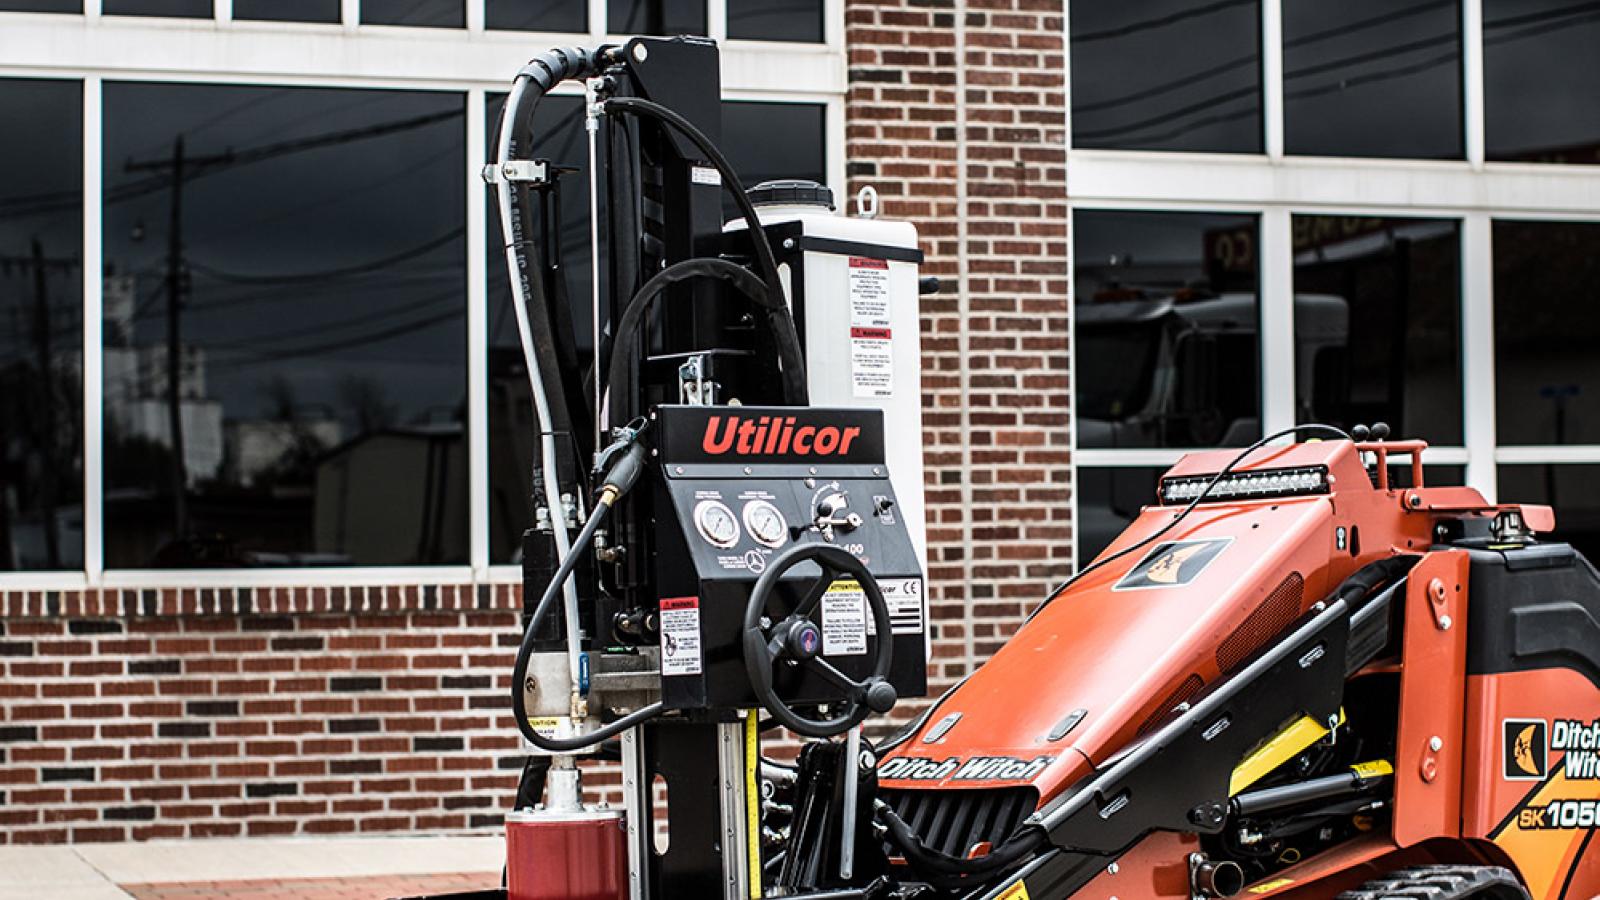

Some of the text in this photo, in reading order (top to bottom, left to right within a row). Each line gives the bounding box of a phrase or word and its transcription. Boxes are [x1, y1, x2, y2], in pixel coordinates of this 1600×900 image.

[702, 416, 861, 455] Utilicor
[1552, 720, 1600, 750] Ditch
[878, 757, 1049, 779] Ditch Witch
